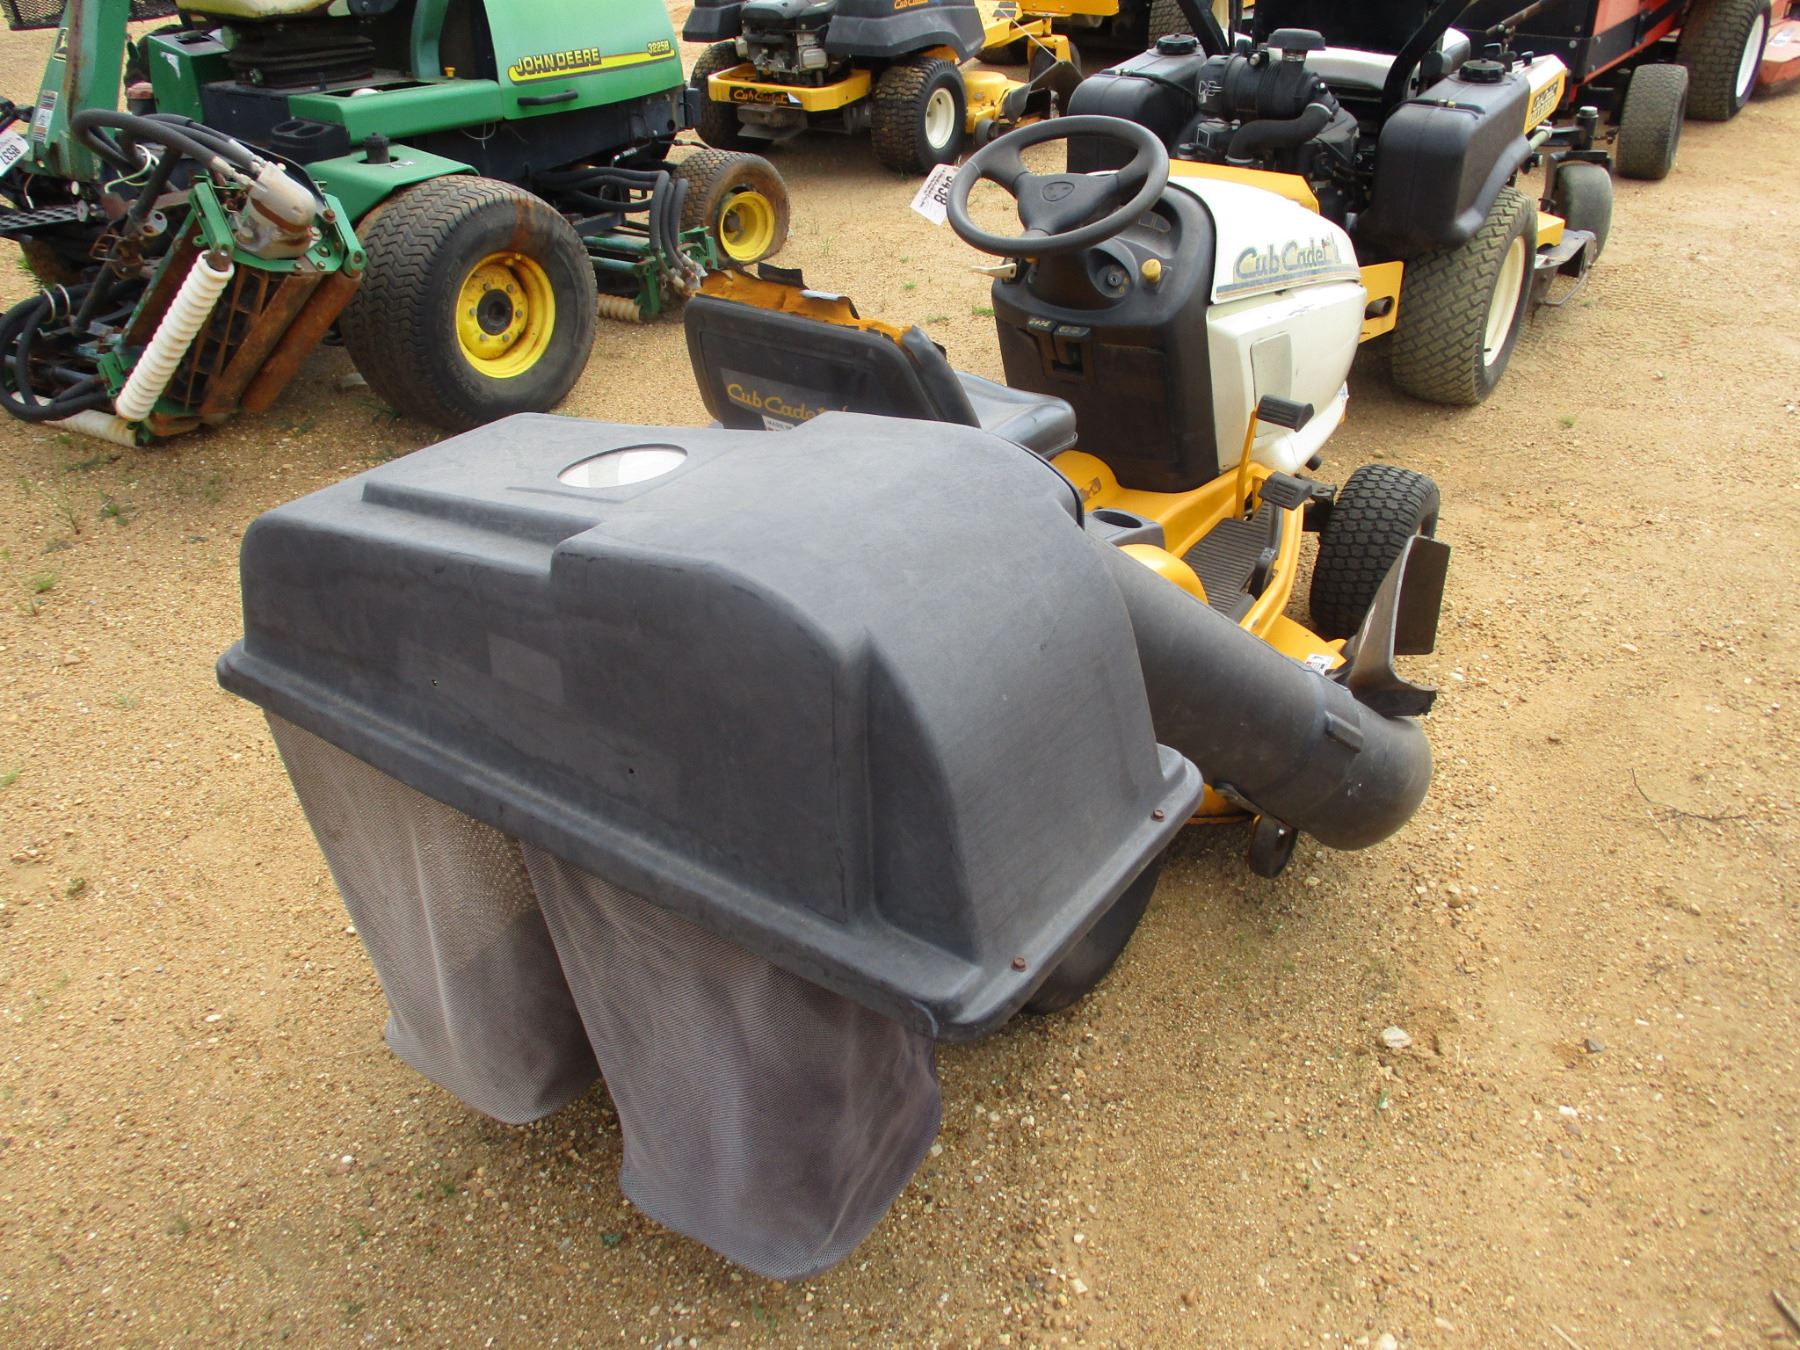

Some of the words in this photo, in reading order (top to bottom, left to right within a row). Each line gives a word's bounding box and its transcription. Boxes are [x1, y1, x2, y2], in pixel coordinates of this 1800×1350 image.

[515, 53, 556, 75] JOHN
[556, 48, 601, 68] DEERE
[1235, 243, 1281, 279] Cub
[727, 383, 762, 408] Cub
